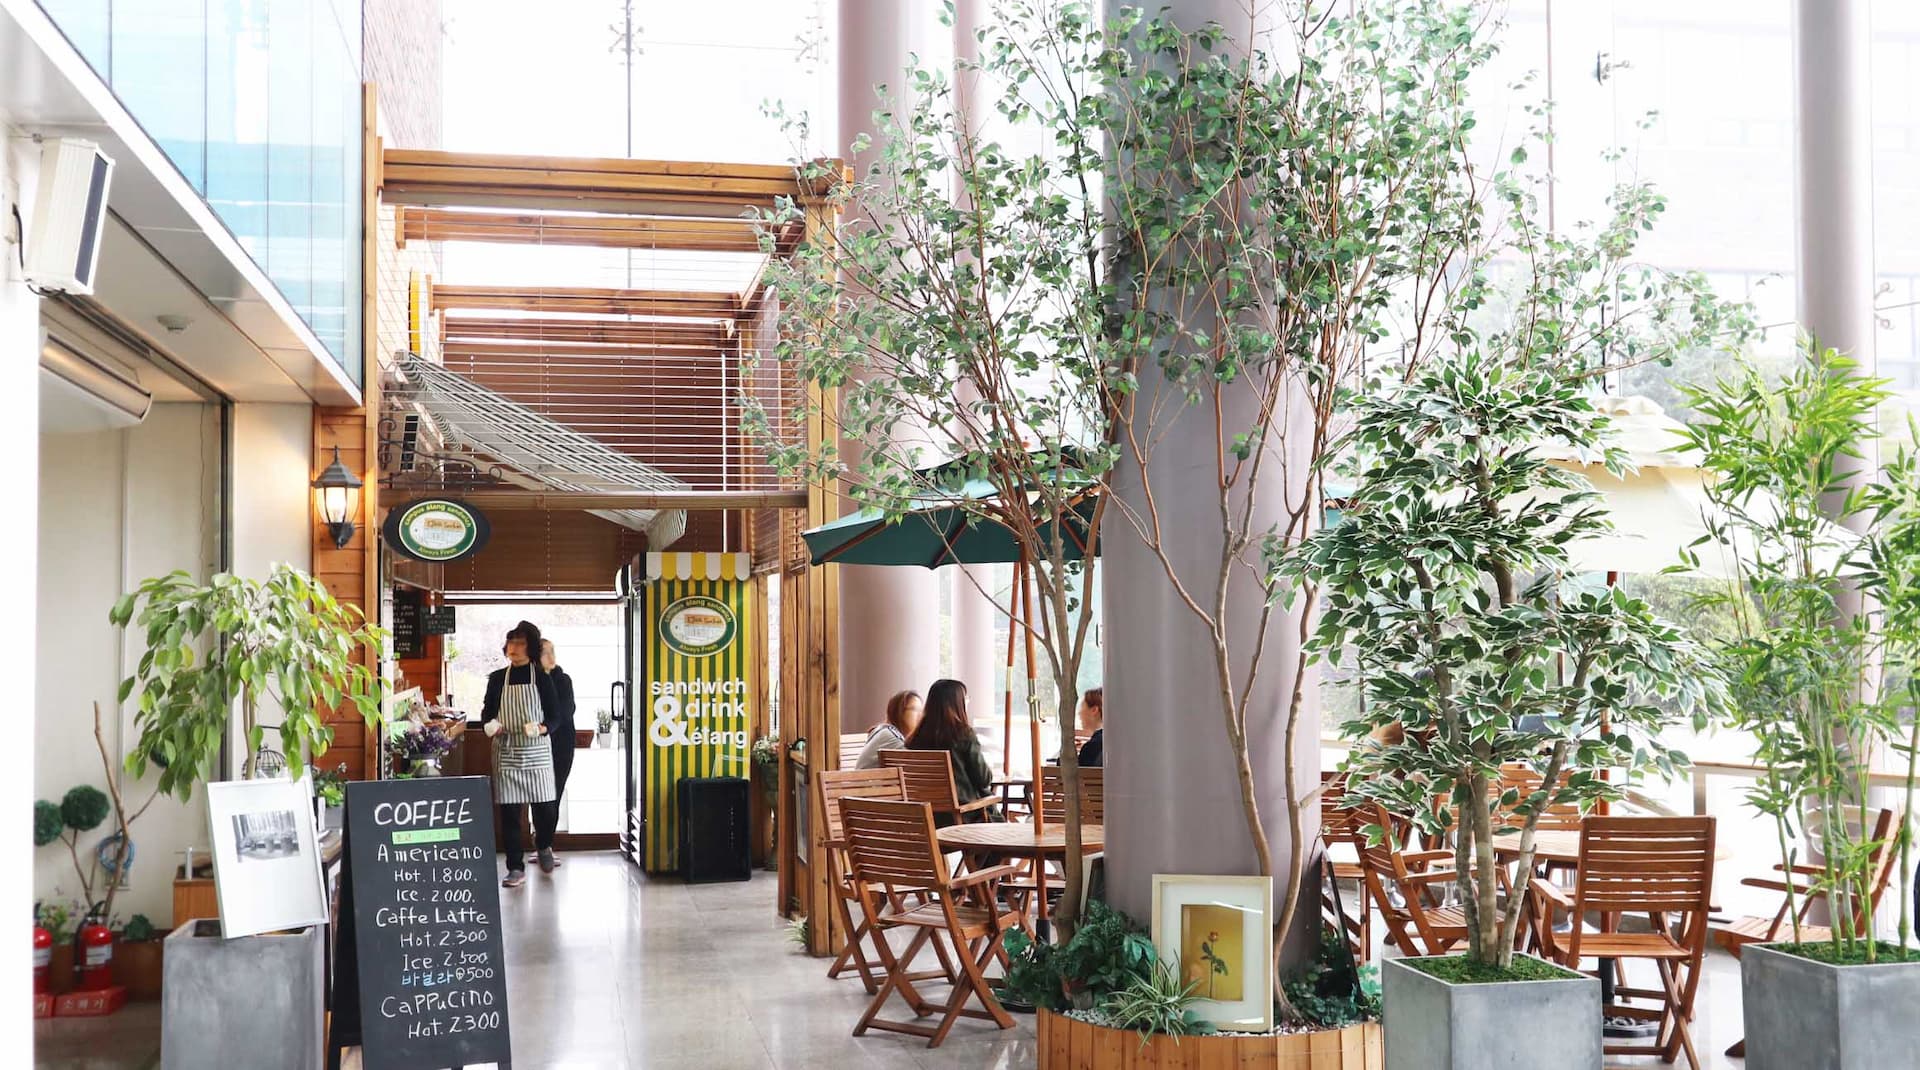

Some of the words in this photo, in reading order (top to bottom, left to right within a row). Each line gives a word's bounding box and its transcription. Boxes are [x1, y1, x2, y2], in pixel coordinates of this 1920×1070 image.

[651, 677, 746, 695] sandwich
[649, 696, 691, 747] &
[685, 698, 746, 718] drink
[691, 726, 747, 749] étang
[374, 798, 473, 827] COFFEE
[377, 844, 483, 863] Americano
[376, 907, 429, 927] Caffe
[435, 907, 489, 924] Latte
[439, 929, 488, 946] 2.300
